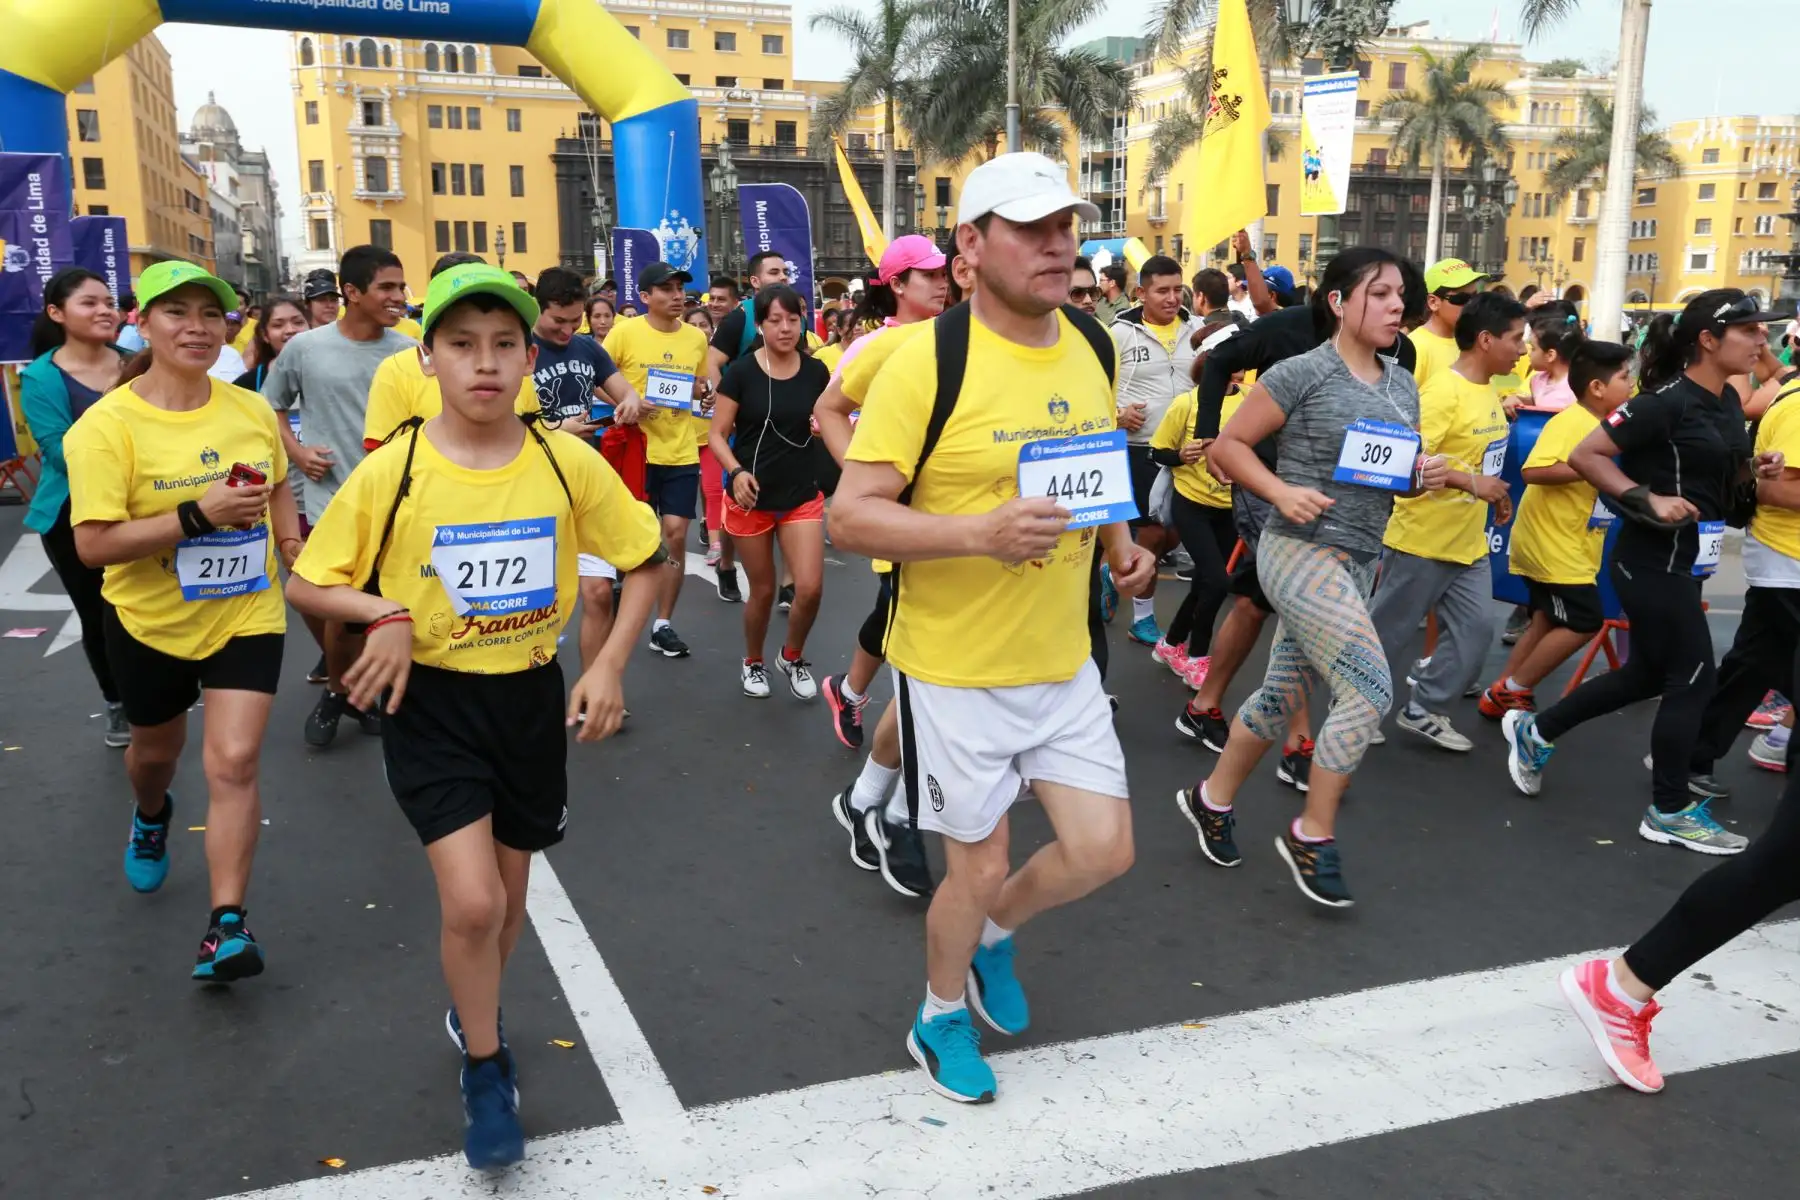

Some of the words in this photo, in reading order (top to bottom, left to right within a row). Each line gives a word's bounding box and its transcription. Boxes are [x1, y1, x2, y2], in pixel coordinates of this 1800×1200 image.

[382, 0, 404, 11] de
[408, 0, 450, 14] Lima
[27, 173, 44, 211] Lima
[29, 214, 48, 234] de
[103, 228, 115, 253] Lima
[104, 255, 116, 268] de
[623, 238, 634, 301] Municipalidad
[532, 362, 568, 391] THIS
[568, 359, 596, 379] GUY
[658, 382, 678, 396] 869
[557, 404, 586, 416] EEDS
[993, 424, 1078, 443] Municipalidad
[1081, 419, 1094, 432] de
[1361, 442, 1392, 465] 309
[154, 467, 232, 491] Municipalidad
[1046, 469, 1104, 500] 4442
[202, 535, 242, 544] Municipalidad
[457, 528, 510, 540] Municipalidad
[511, 527, 521, 536] de
[523, 526, 541, 535] Lima
[198, 555, 248, 578] 2171
[457, 556, 527, 589] 2172
[199, 583, 248, 595] LIMACORRE
[470, 597, 528, 611] MACORRE
[449, 641, 474, 651] LIMA
[477, 635, 512, 647] CORRE
[515, 629, 534, 643] CON
[536, 626, 544, 635] EL
